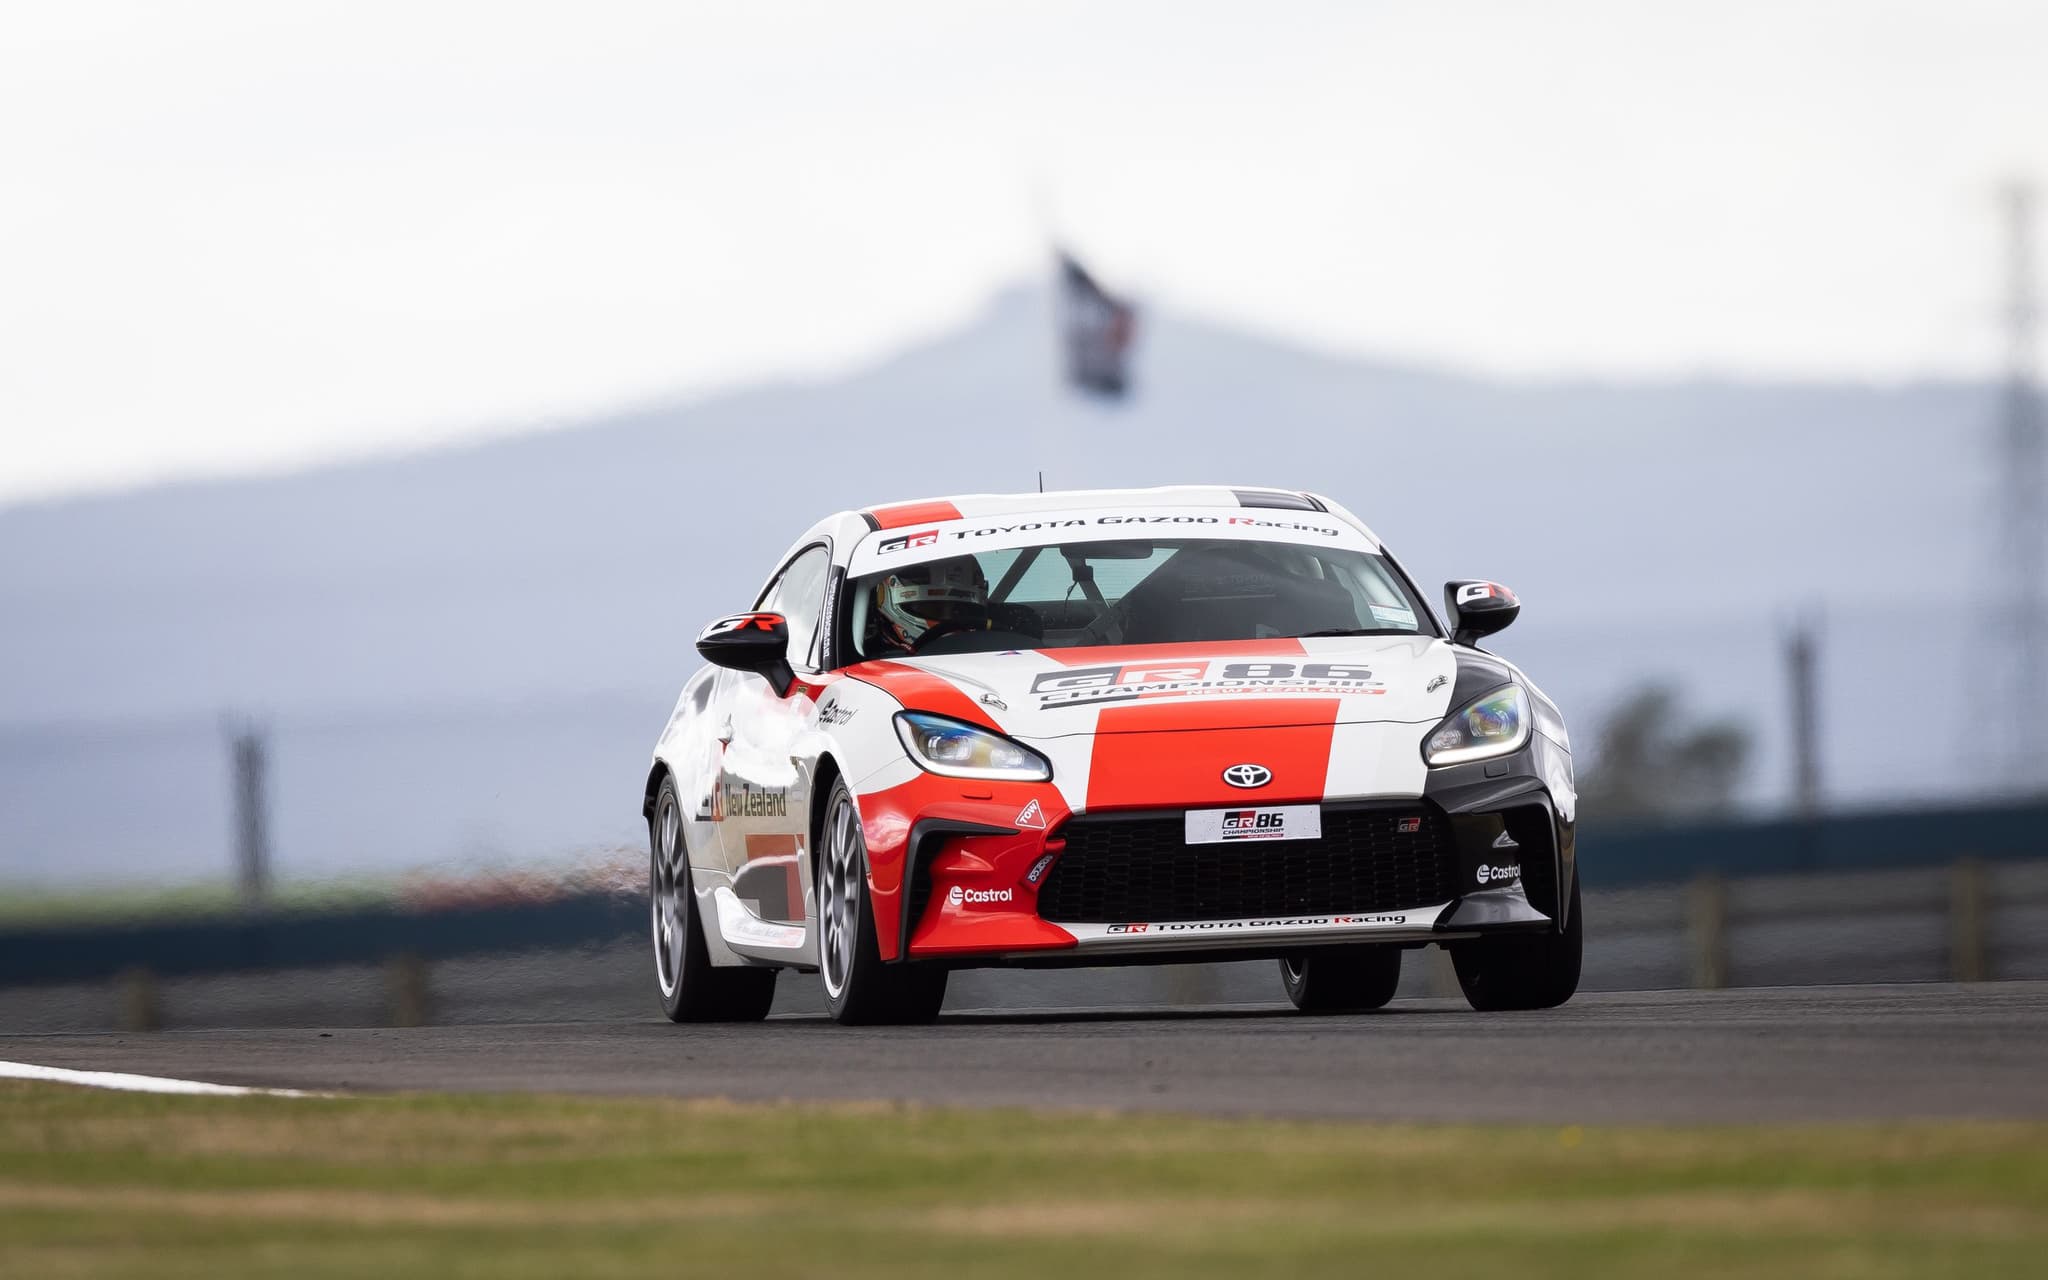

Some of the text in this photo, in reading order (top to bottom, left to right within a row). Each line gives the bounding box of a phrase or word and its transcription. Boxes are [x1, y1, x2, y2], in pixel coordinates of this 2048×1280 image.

[878, 516, 1339, 555] GR TOYOTA GAZOO Racing
[699, 614, 785, 641] GR
[1033, 663, 1373, 693] GR 86
[1040, 680, 1384, 701] CHAMPIONSHIP
[1185, 687, 1376, 696] NEW ZEALAND
[743, 784, 787, 817] Zealand
[1020, 803, 1038, 824] TOW
[1223, 813, 1284, 829] GR 86
[1399, 820, 1420, 832] GR
[1490, 864, 1521, 880] Castrol
[964, 888, 1012, 903] Castrol
[1107, 915, 1406, 933] GR TOYOTA GAZOO Racing
